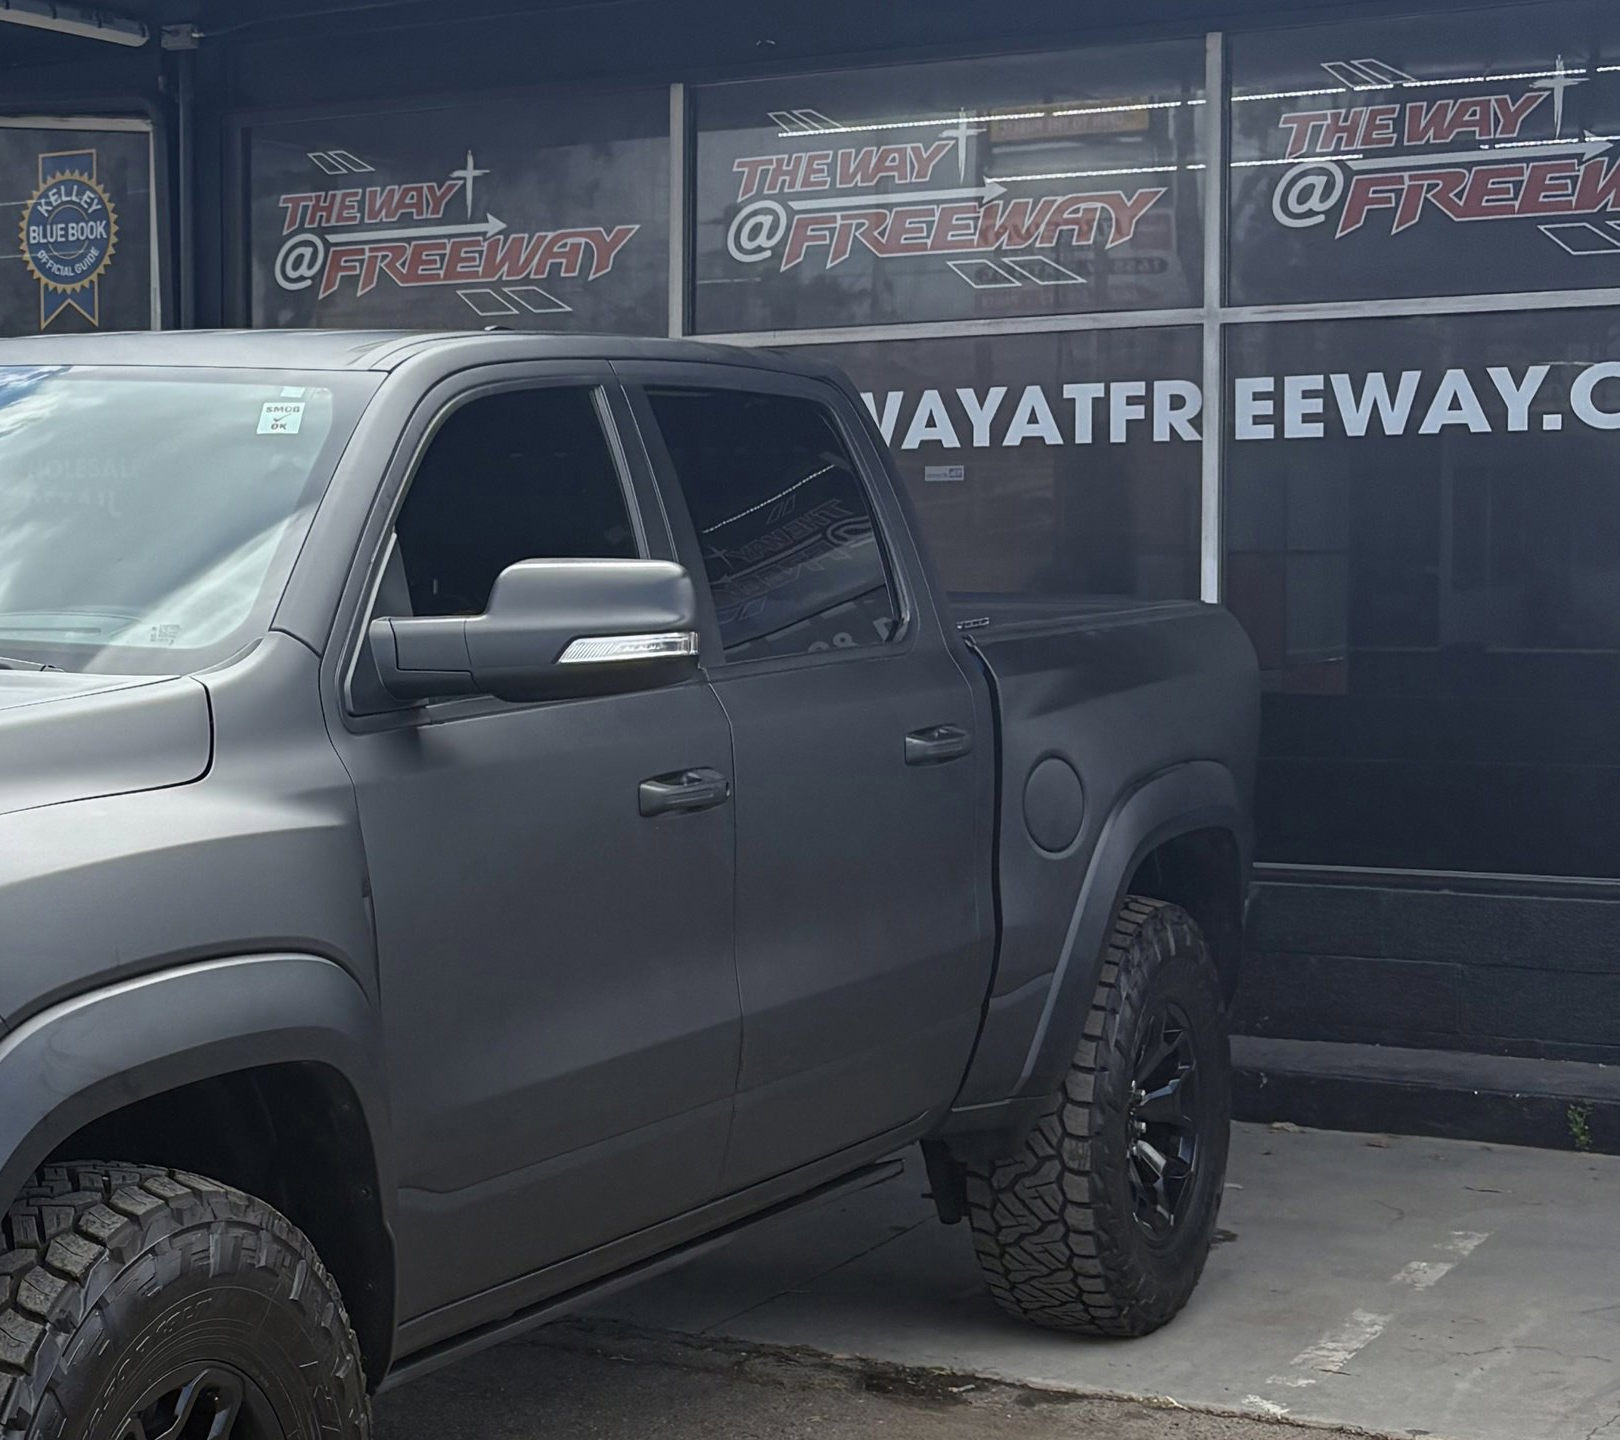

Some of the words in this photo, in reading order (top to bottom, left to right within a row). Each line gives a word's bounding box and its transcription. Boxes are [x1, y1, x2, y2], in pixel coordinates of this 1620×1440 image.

[1278, 103, 1400, 161] THE
[1404, 90, 1552, 147] WAY
[732, 150, 832, 203] THE
[835, 140, 956, 188] WAY
[37, 184, 102, 217] KELLEY
[278, 188, 362, 236] THE
[365, 179, 465, 224] WAY
[29, 223, 66, 244] BLUE
[68, 220, 107, 241] BOOK
[36, 249, 75, 276] OFFICIAL
[74, 246, 100, 274] GUIDE
